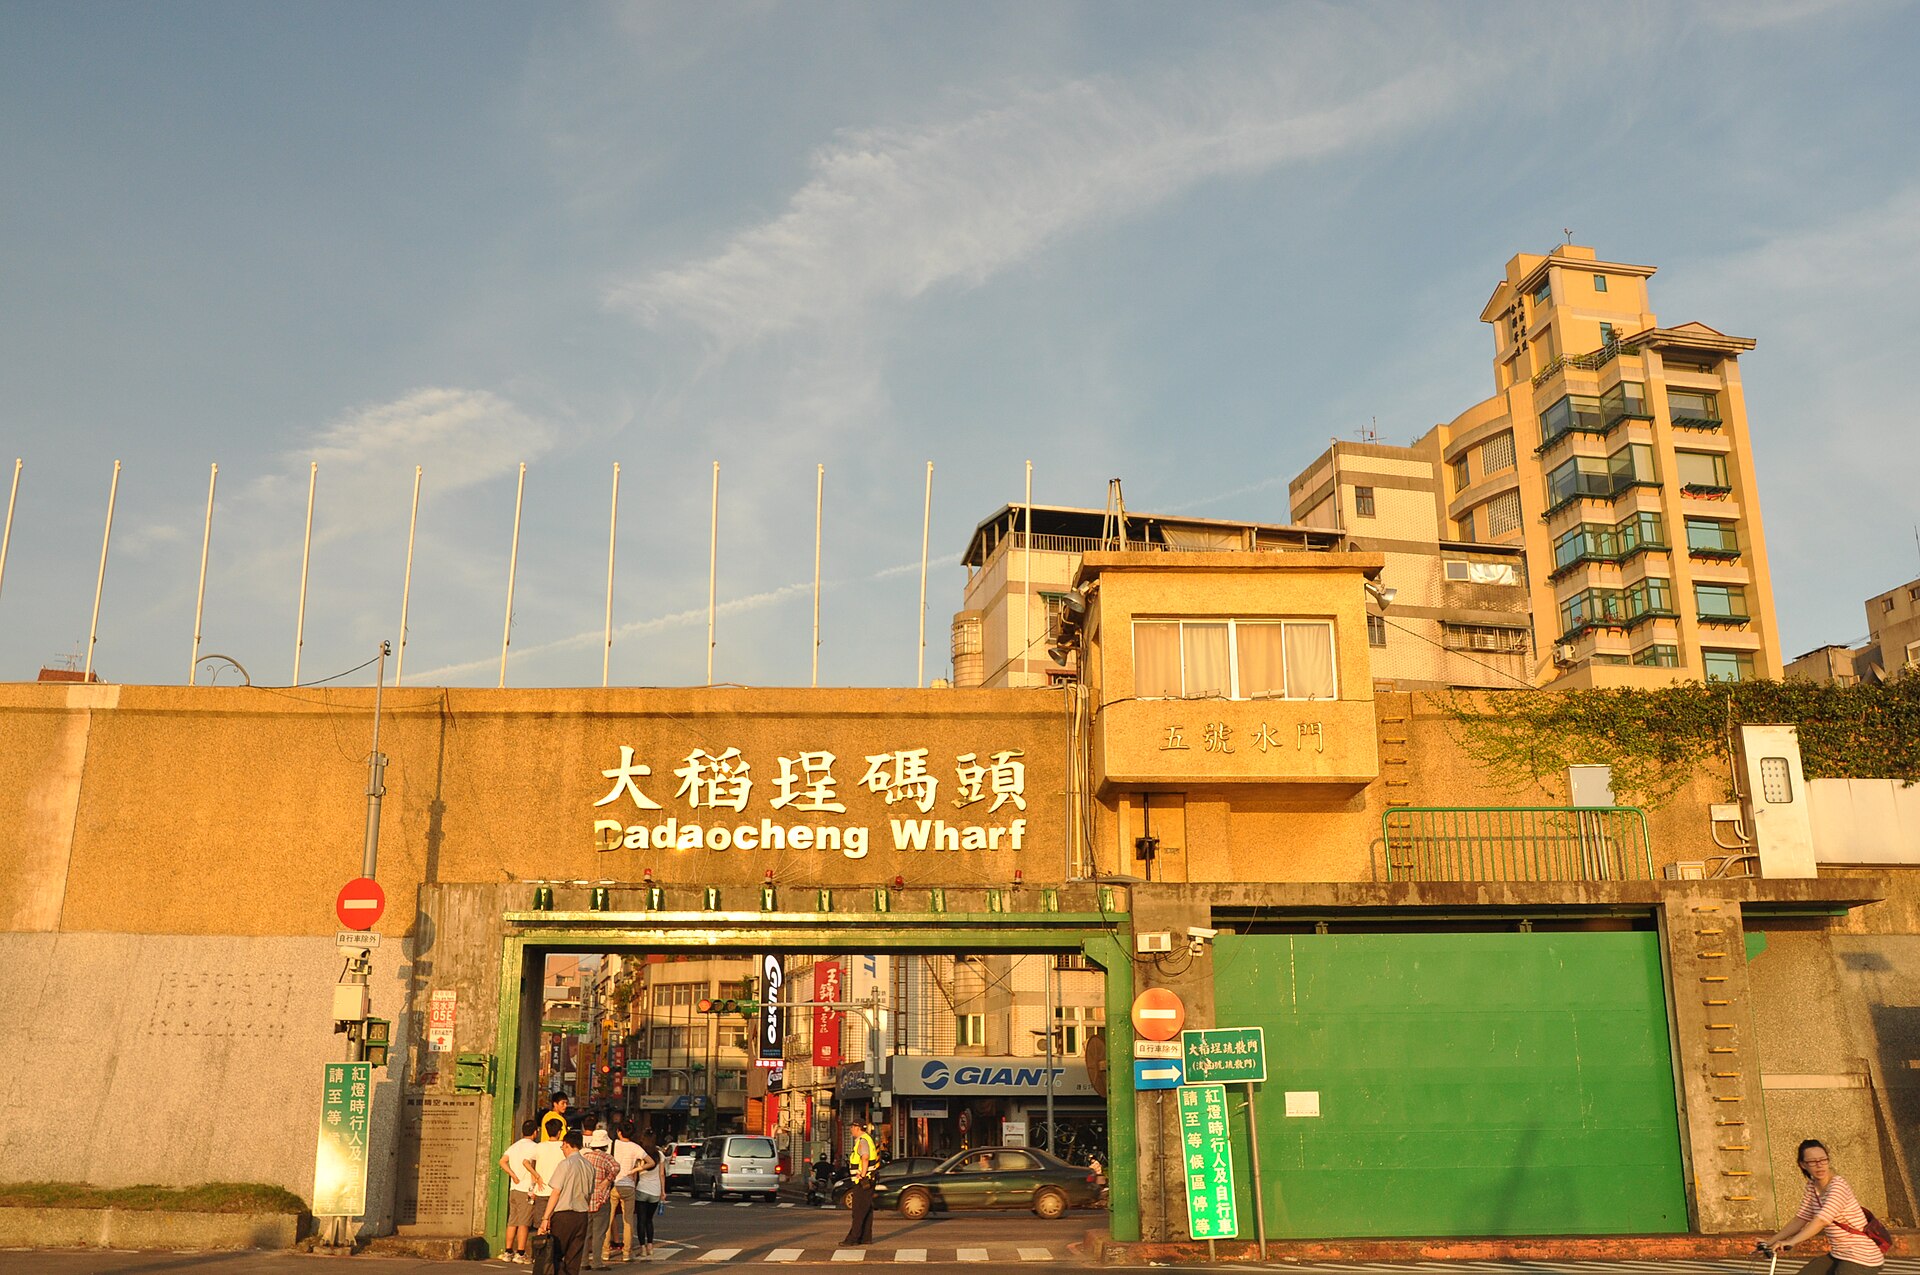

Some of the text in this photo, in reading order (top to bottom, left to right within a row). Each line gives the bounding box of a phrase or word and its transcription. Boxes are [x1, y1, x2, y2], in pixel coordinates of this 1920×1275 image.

[1159, 721, 1324, 754] 五號水門
[593, 745, 1028, 815] 大稻埕碼頭
[594, 818, 1028, 859] Dadaocheng Wharf
[338, 933, 377, 945] 自行車除外
[433, 1010, 453, 1021] 05E
[1139, 1044, 1178, 1053] 自行車除外
[1188, 1040, 1258, 1056] 大稻埕疏散門
[954, 1067, 1065, 1087] GIANT
[1182, 1090, 1210, 1235] 請至等候區停等
[1204, 1088, 1234, 1235] 紅燈時行人及自行車
